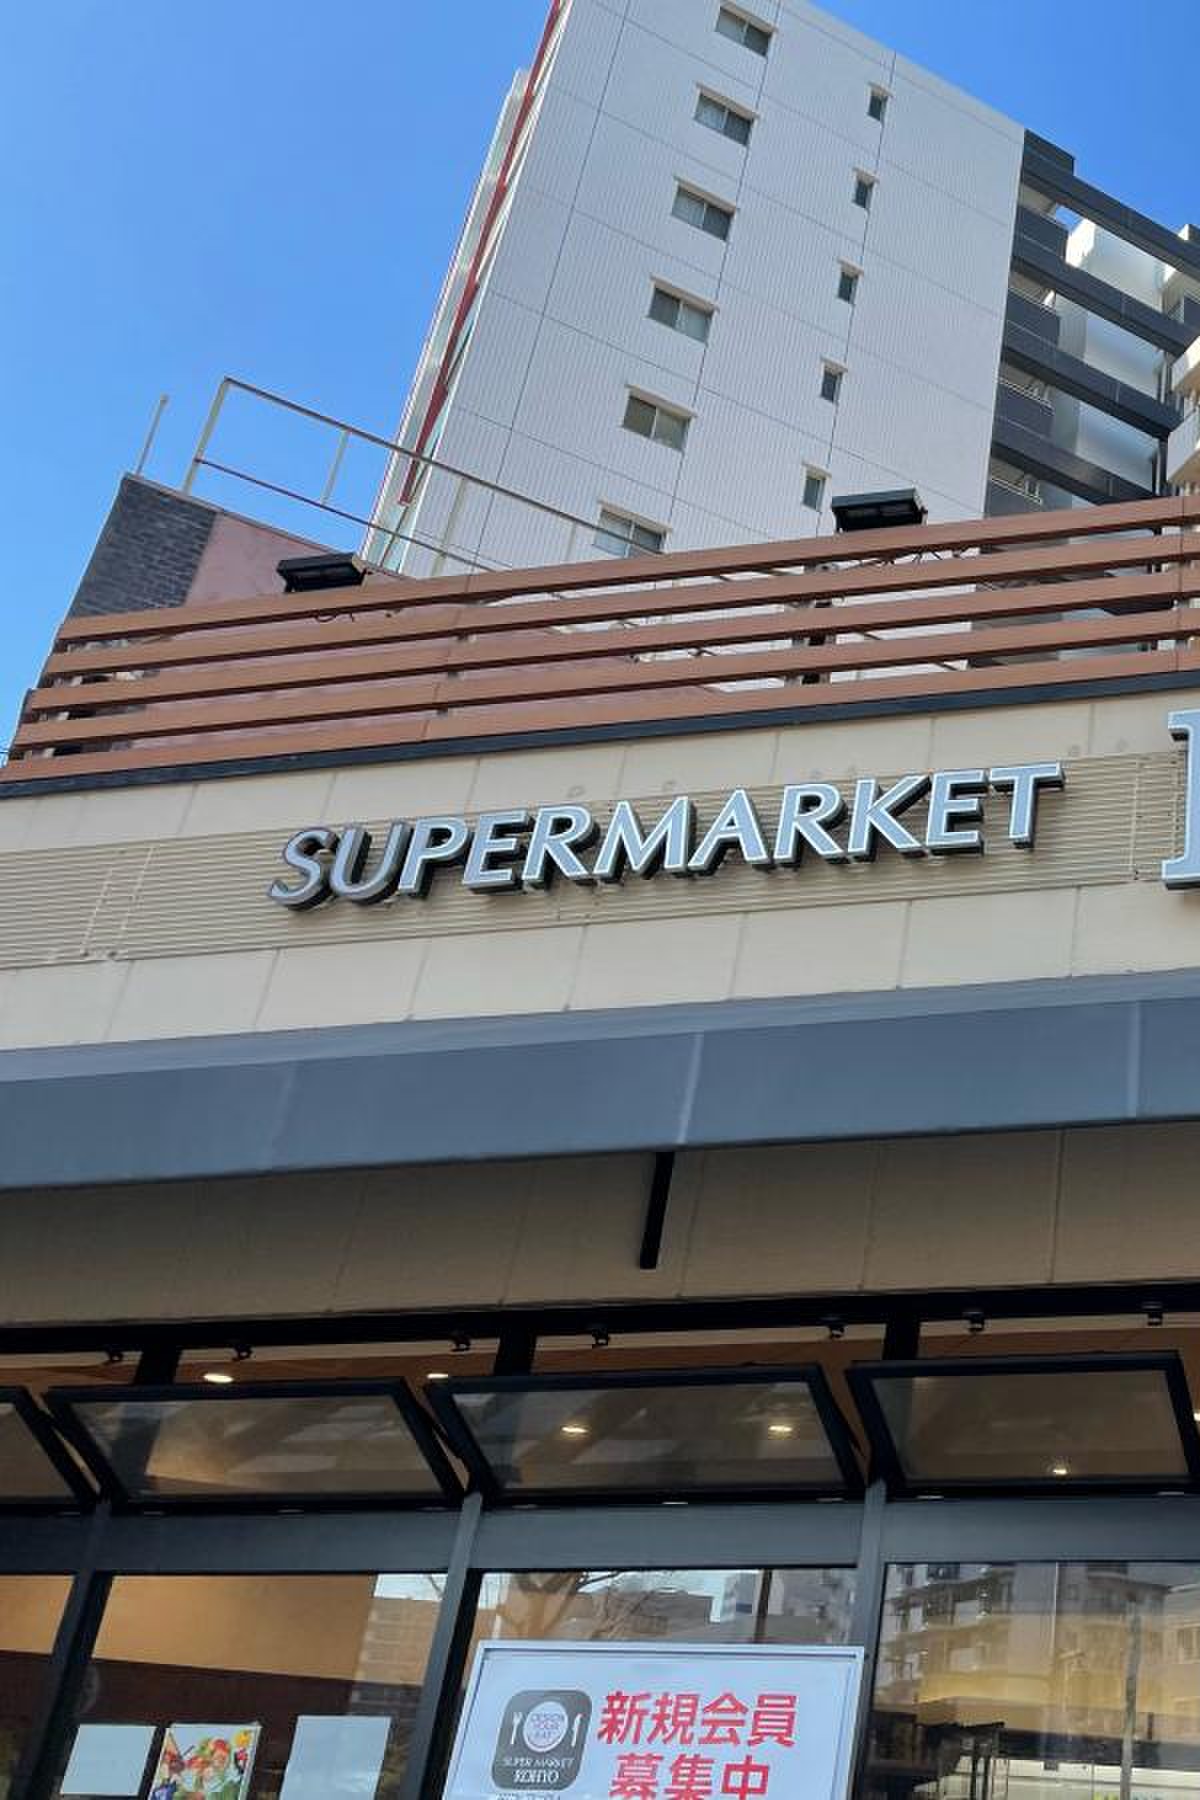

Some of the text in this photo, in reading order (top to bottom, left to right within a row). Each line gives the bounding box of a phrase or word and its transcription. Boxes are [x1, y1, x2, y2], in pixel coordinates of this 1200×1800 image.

[271, 761, 1065, 910] SUPERMARKET
[597, 1691, 797, 1746] 新規会員
[608, 1753, 770, 1800] 募集中
